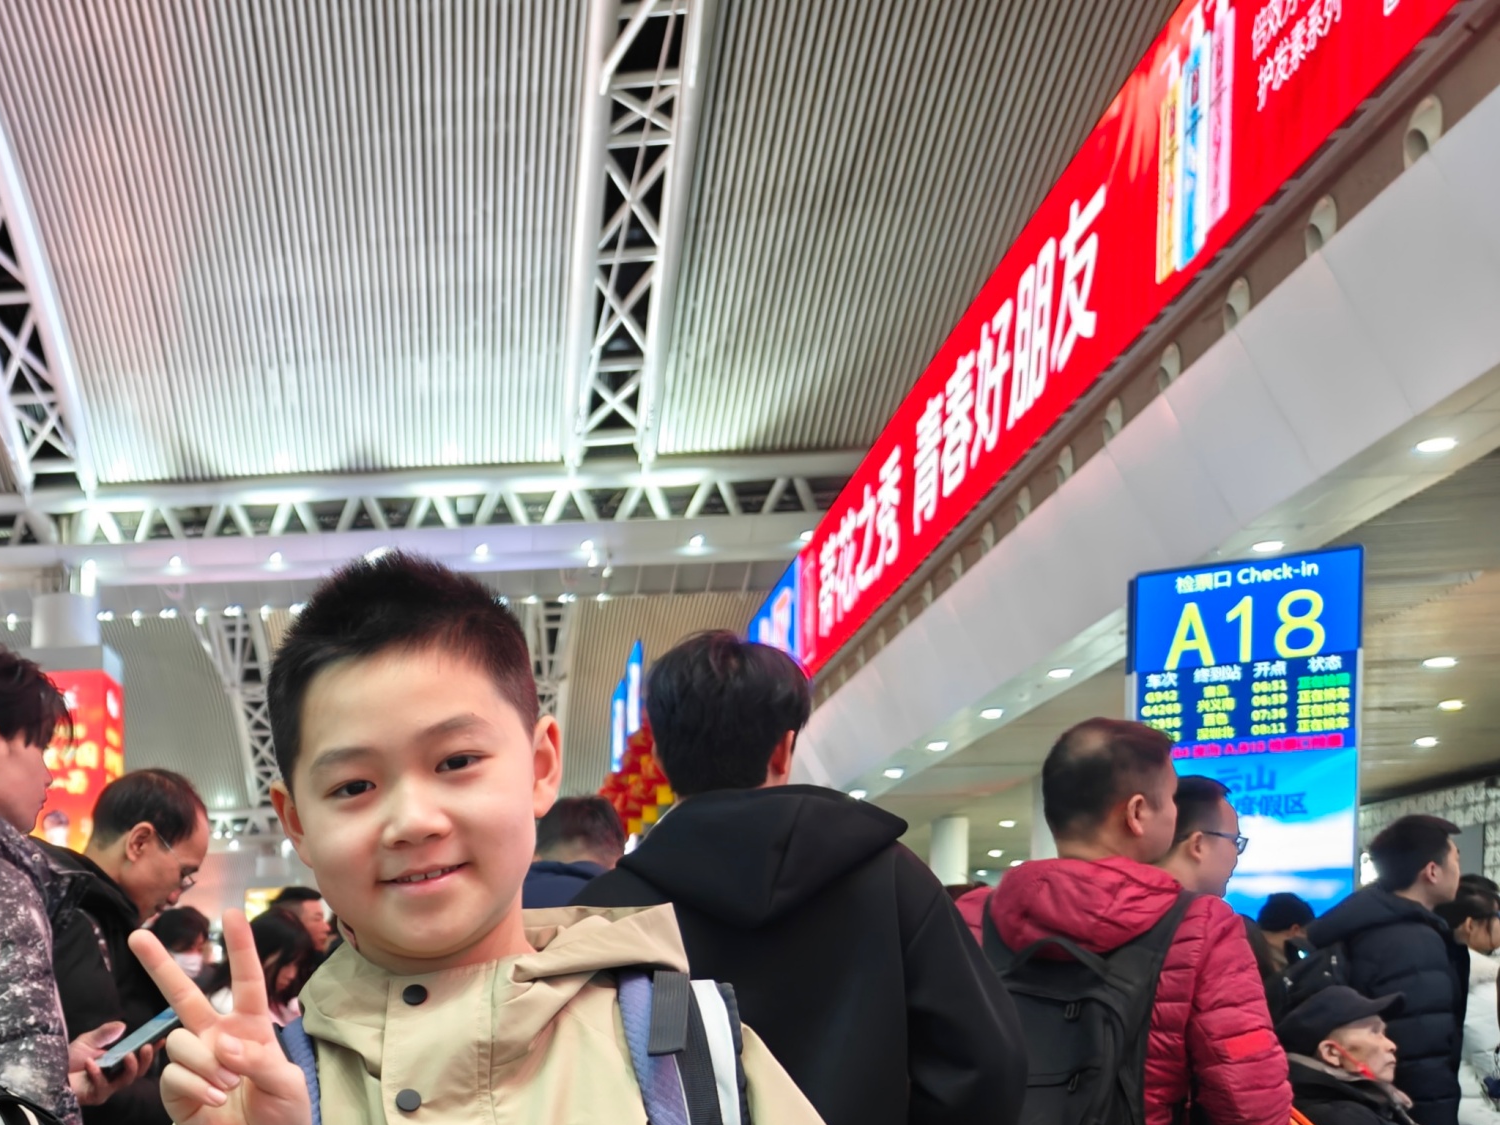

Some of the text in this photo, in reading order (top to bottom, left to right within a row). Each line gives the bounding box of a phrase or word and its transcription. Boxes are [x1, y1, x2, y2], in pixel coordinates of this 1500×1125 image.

[912, 182, 1107, 536] 青春好朋友
[1175, 560, 1319, 595] 检票口 Check-in
[1163, 588, 1326, 672] A18
[1145, 655, 1343, 690] 车次 终到站 开点 状态
